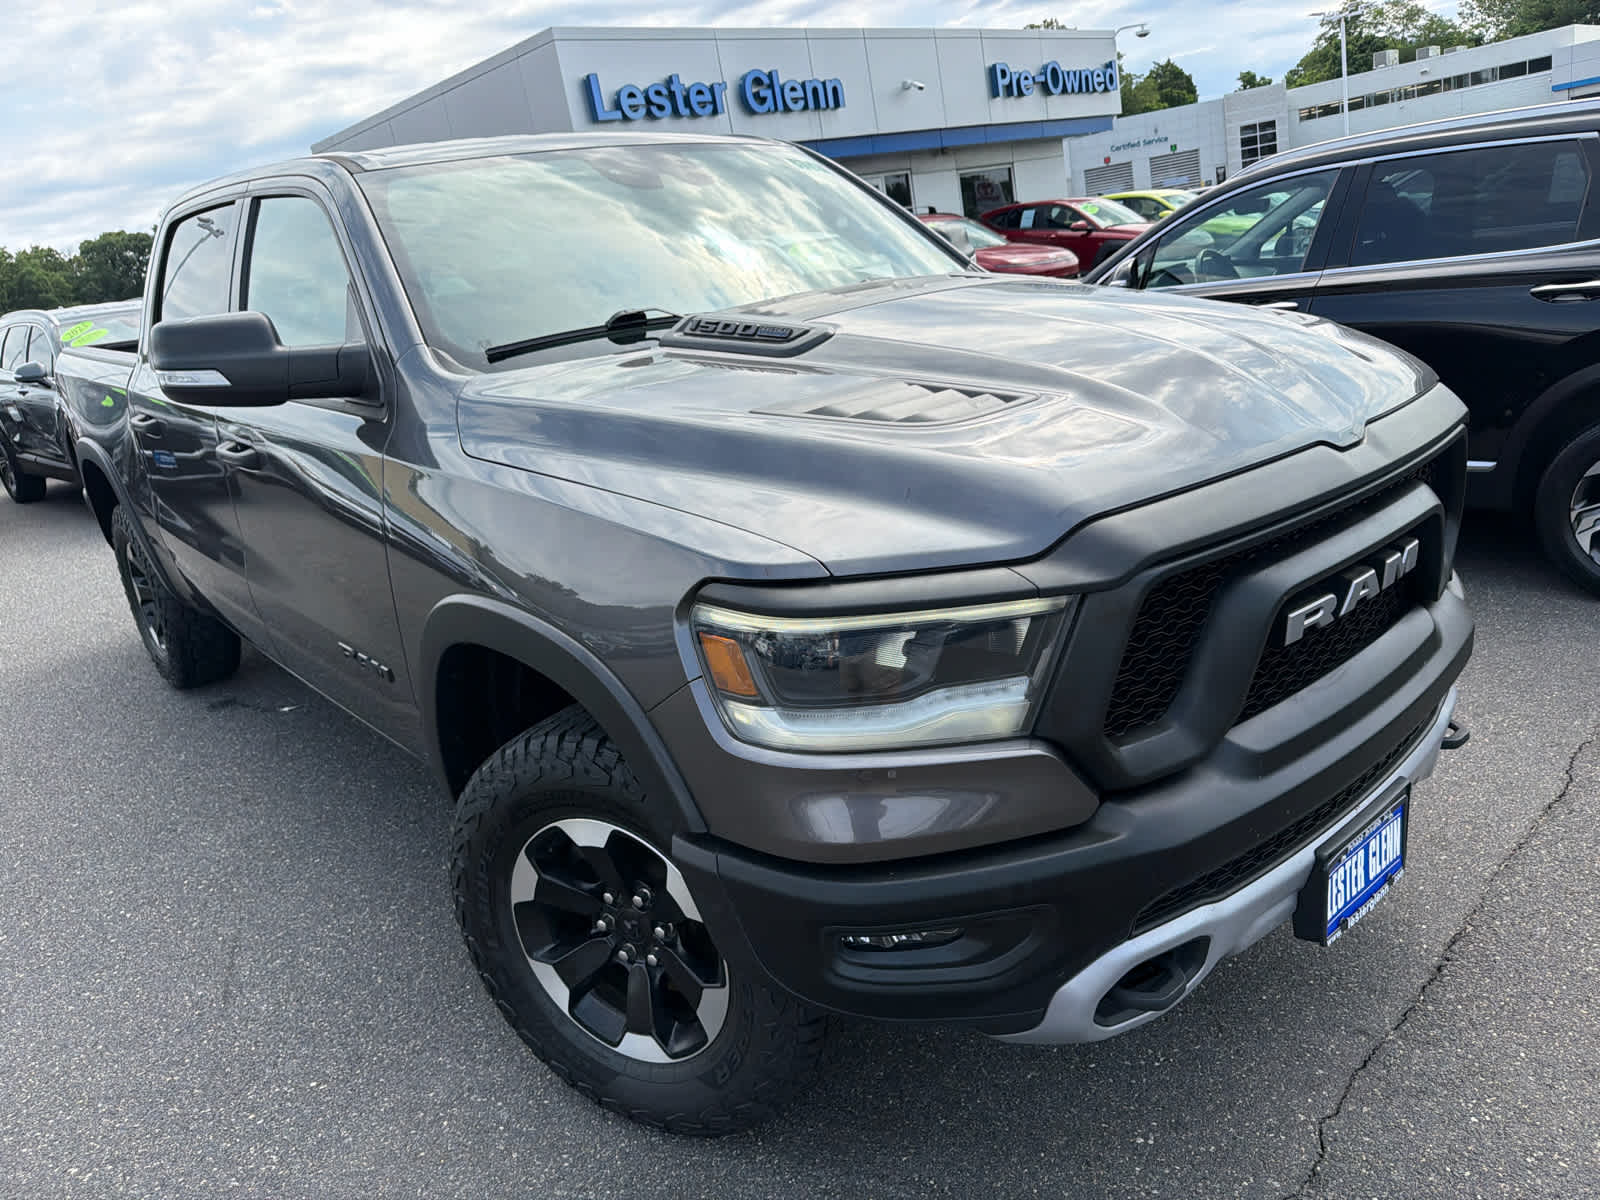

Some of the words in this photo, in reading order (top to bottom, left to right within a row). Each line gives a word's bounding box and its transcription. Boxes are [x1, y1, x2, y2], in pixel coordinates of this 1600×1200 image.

[585, 73, 727, 121] Lester
[740, 69, 846, 114] Glenn
[991, 60, 1117, 97] Pre-Owned
[1110, 140, 1141, 152] Certified
[1142, 136, 1169, 147] Service
[689, 319, 758, 337] 1500
[1284, 539, 1420, 647] RAM
[1328, 848, 1366, 922] LESTER
[1369, 816, 1401, 882] GLENN
